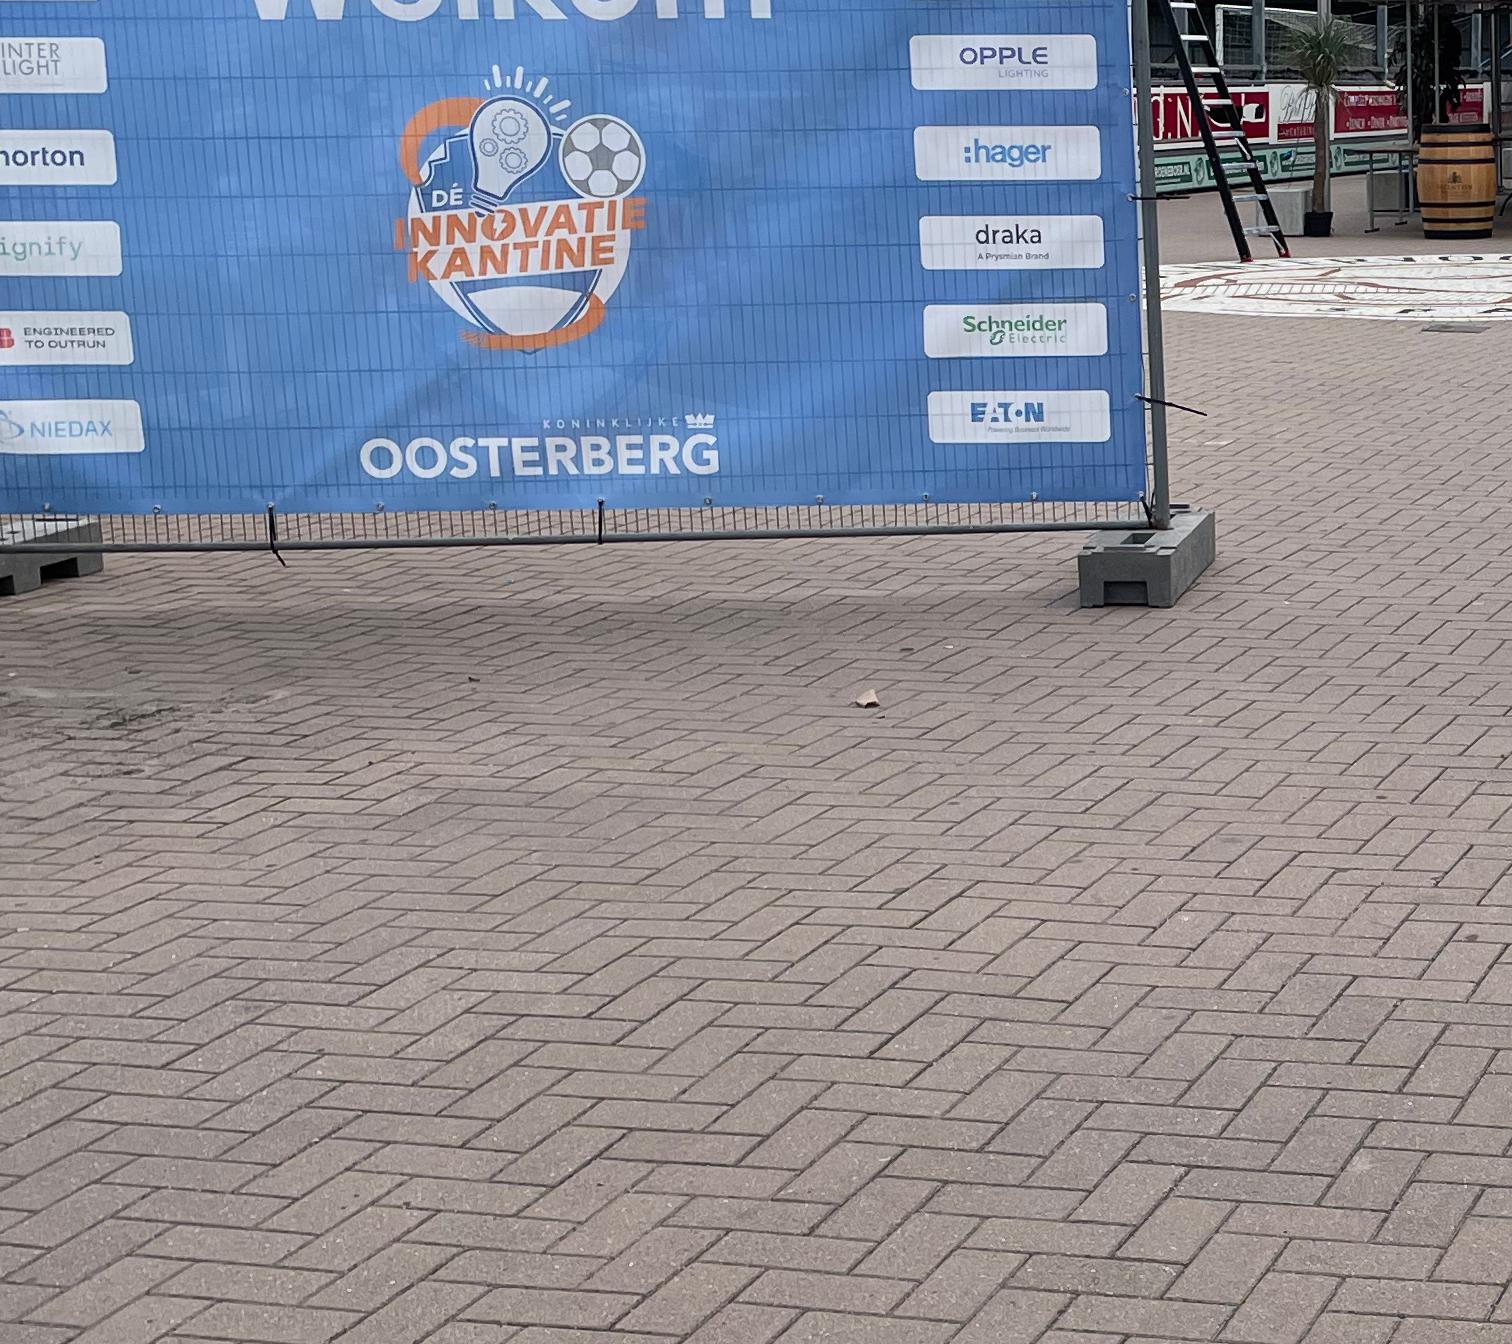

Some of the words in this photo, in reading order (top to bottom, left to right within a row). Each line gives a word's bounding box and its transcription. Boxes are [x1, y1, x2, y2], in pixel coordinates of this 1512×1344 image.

[1, 42, 60, 59] INTER
[959, 47, 1048, 65] OPPLE
[2, 59, 61, 76] LIGHT
[998, 69, 1049, 78] LIGHTING
[431, 182, 464, 207] DÉ
[394, 196, 647, 250] INNOVATIE
[975, 224, 1042, 245] draka
[0, 236, 82, 261] ignify
[407, 234, 616, 282] KANTINE
[23, 327, 115, 337] ENGINEERED
[963, 314, 1067, 332] Schneider
[25, 340, 44, 349] TO
[48, 340, 106, 349] OUTRUN
[1009, 333, 1066, 344] Electric
[970, 402, 1045, 423] EATON
[30, 420, 113, 438] NIEDAX
[543, 416, 679, 430] KONINKLIJKE
[359, 433, 719, 479] OOSTERBERG
